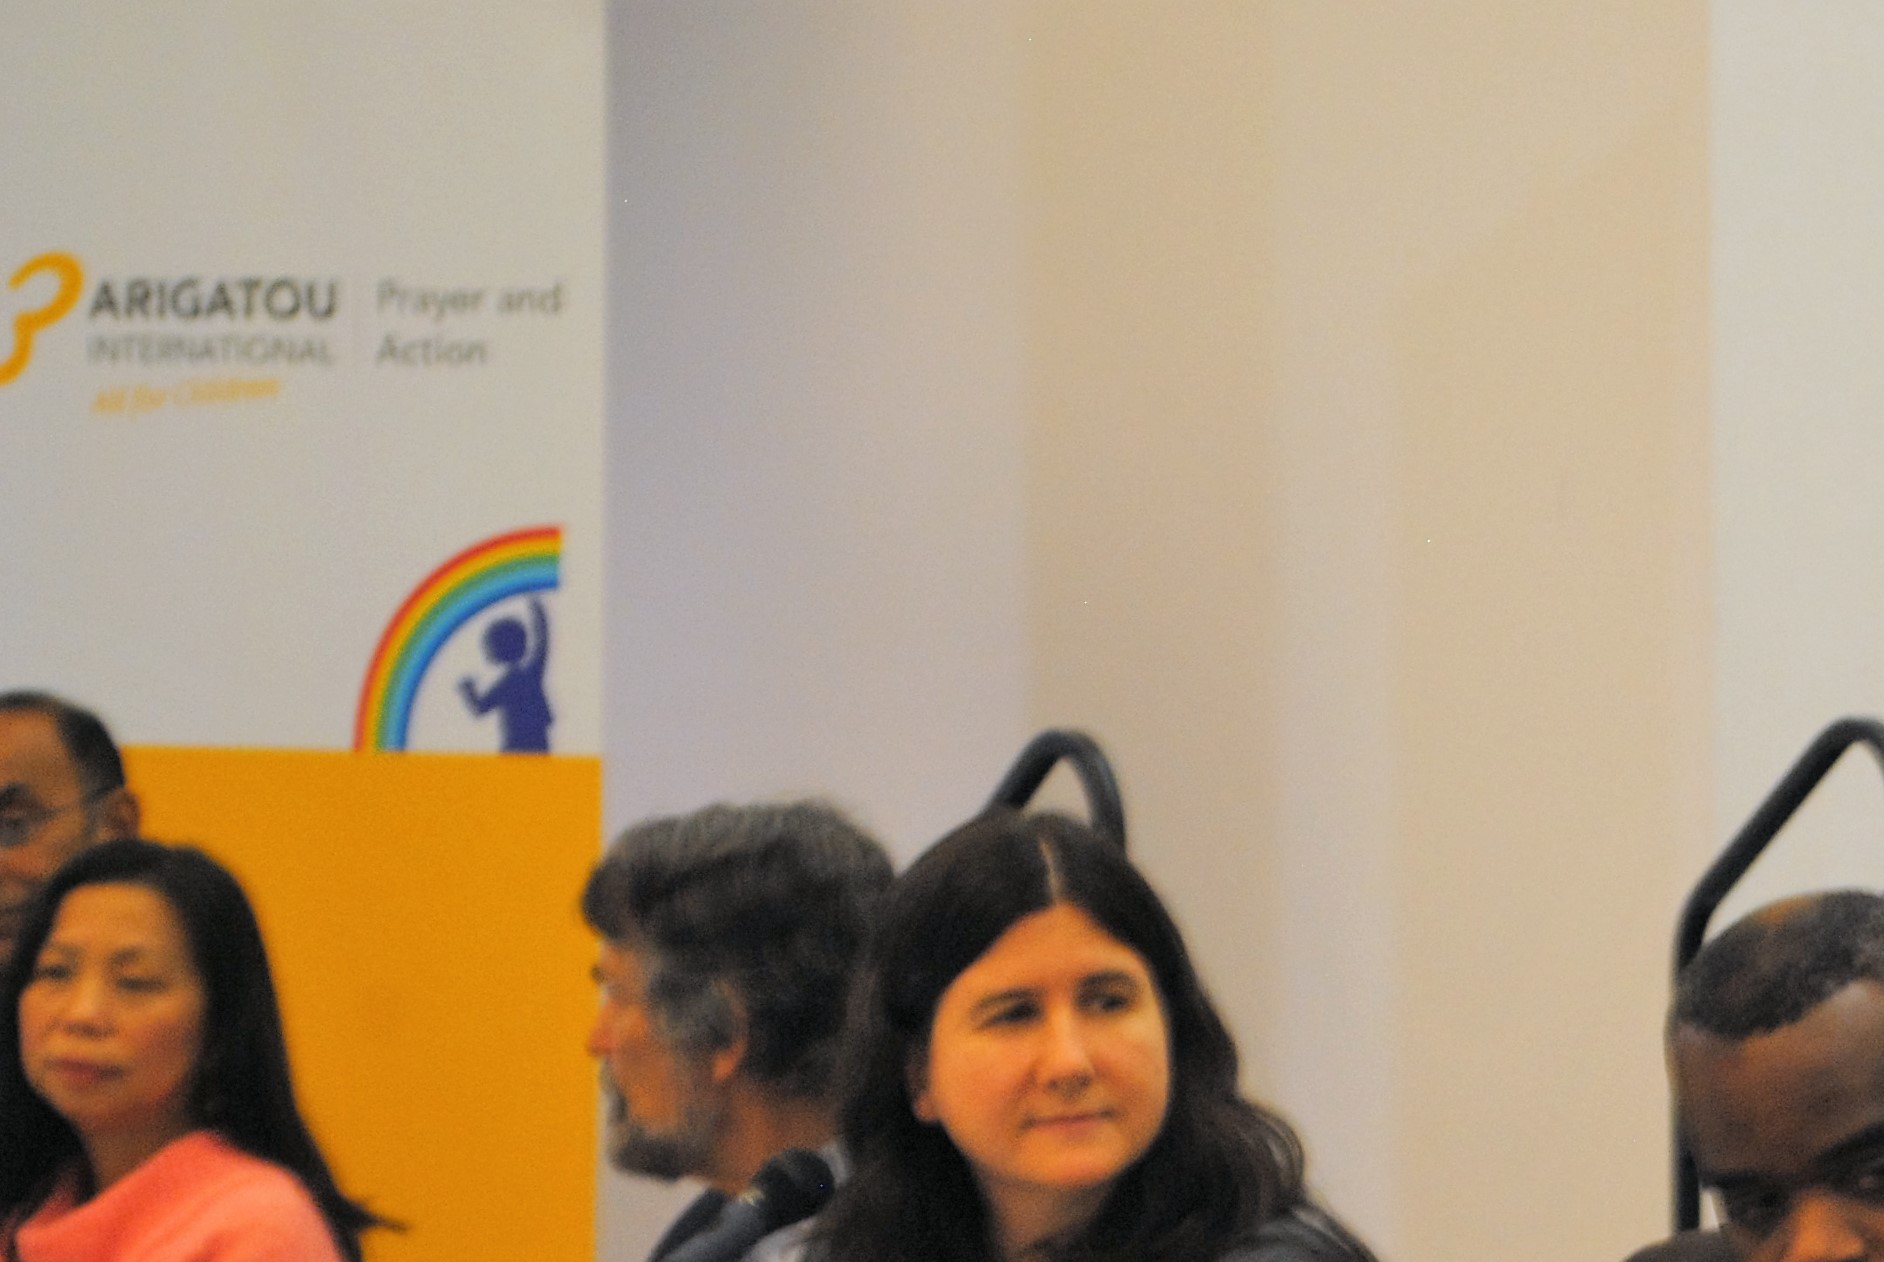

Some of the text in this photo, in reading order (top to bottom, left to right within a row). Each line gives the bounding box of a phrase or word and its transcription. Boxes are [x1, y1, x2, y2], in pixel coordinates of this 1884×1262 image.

[88, 275, 338, 322] ARIGATOU
[376, 277, 563, 323] Prayer and
[86, 333, 335, 367] INTERNATIONAL
[375, 333, 489, 364] Action
